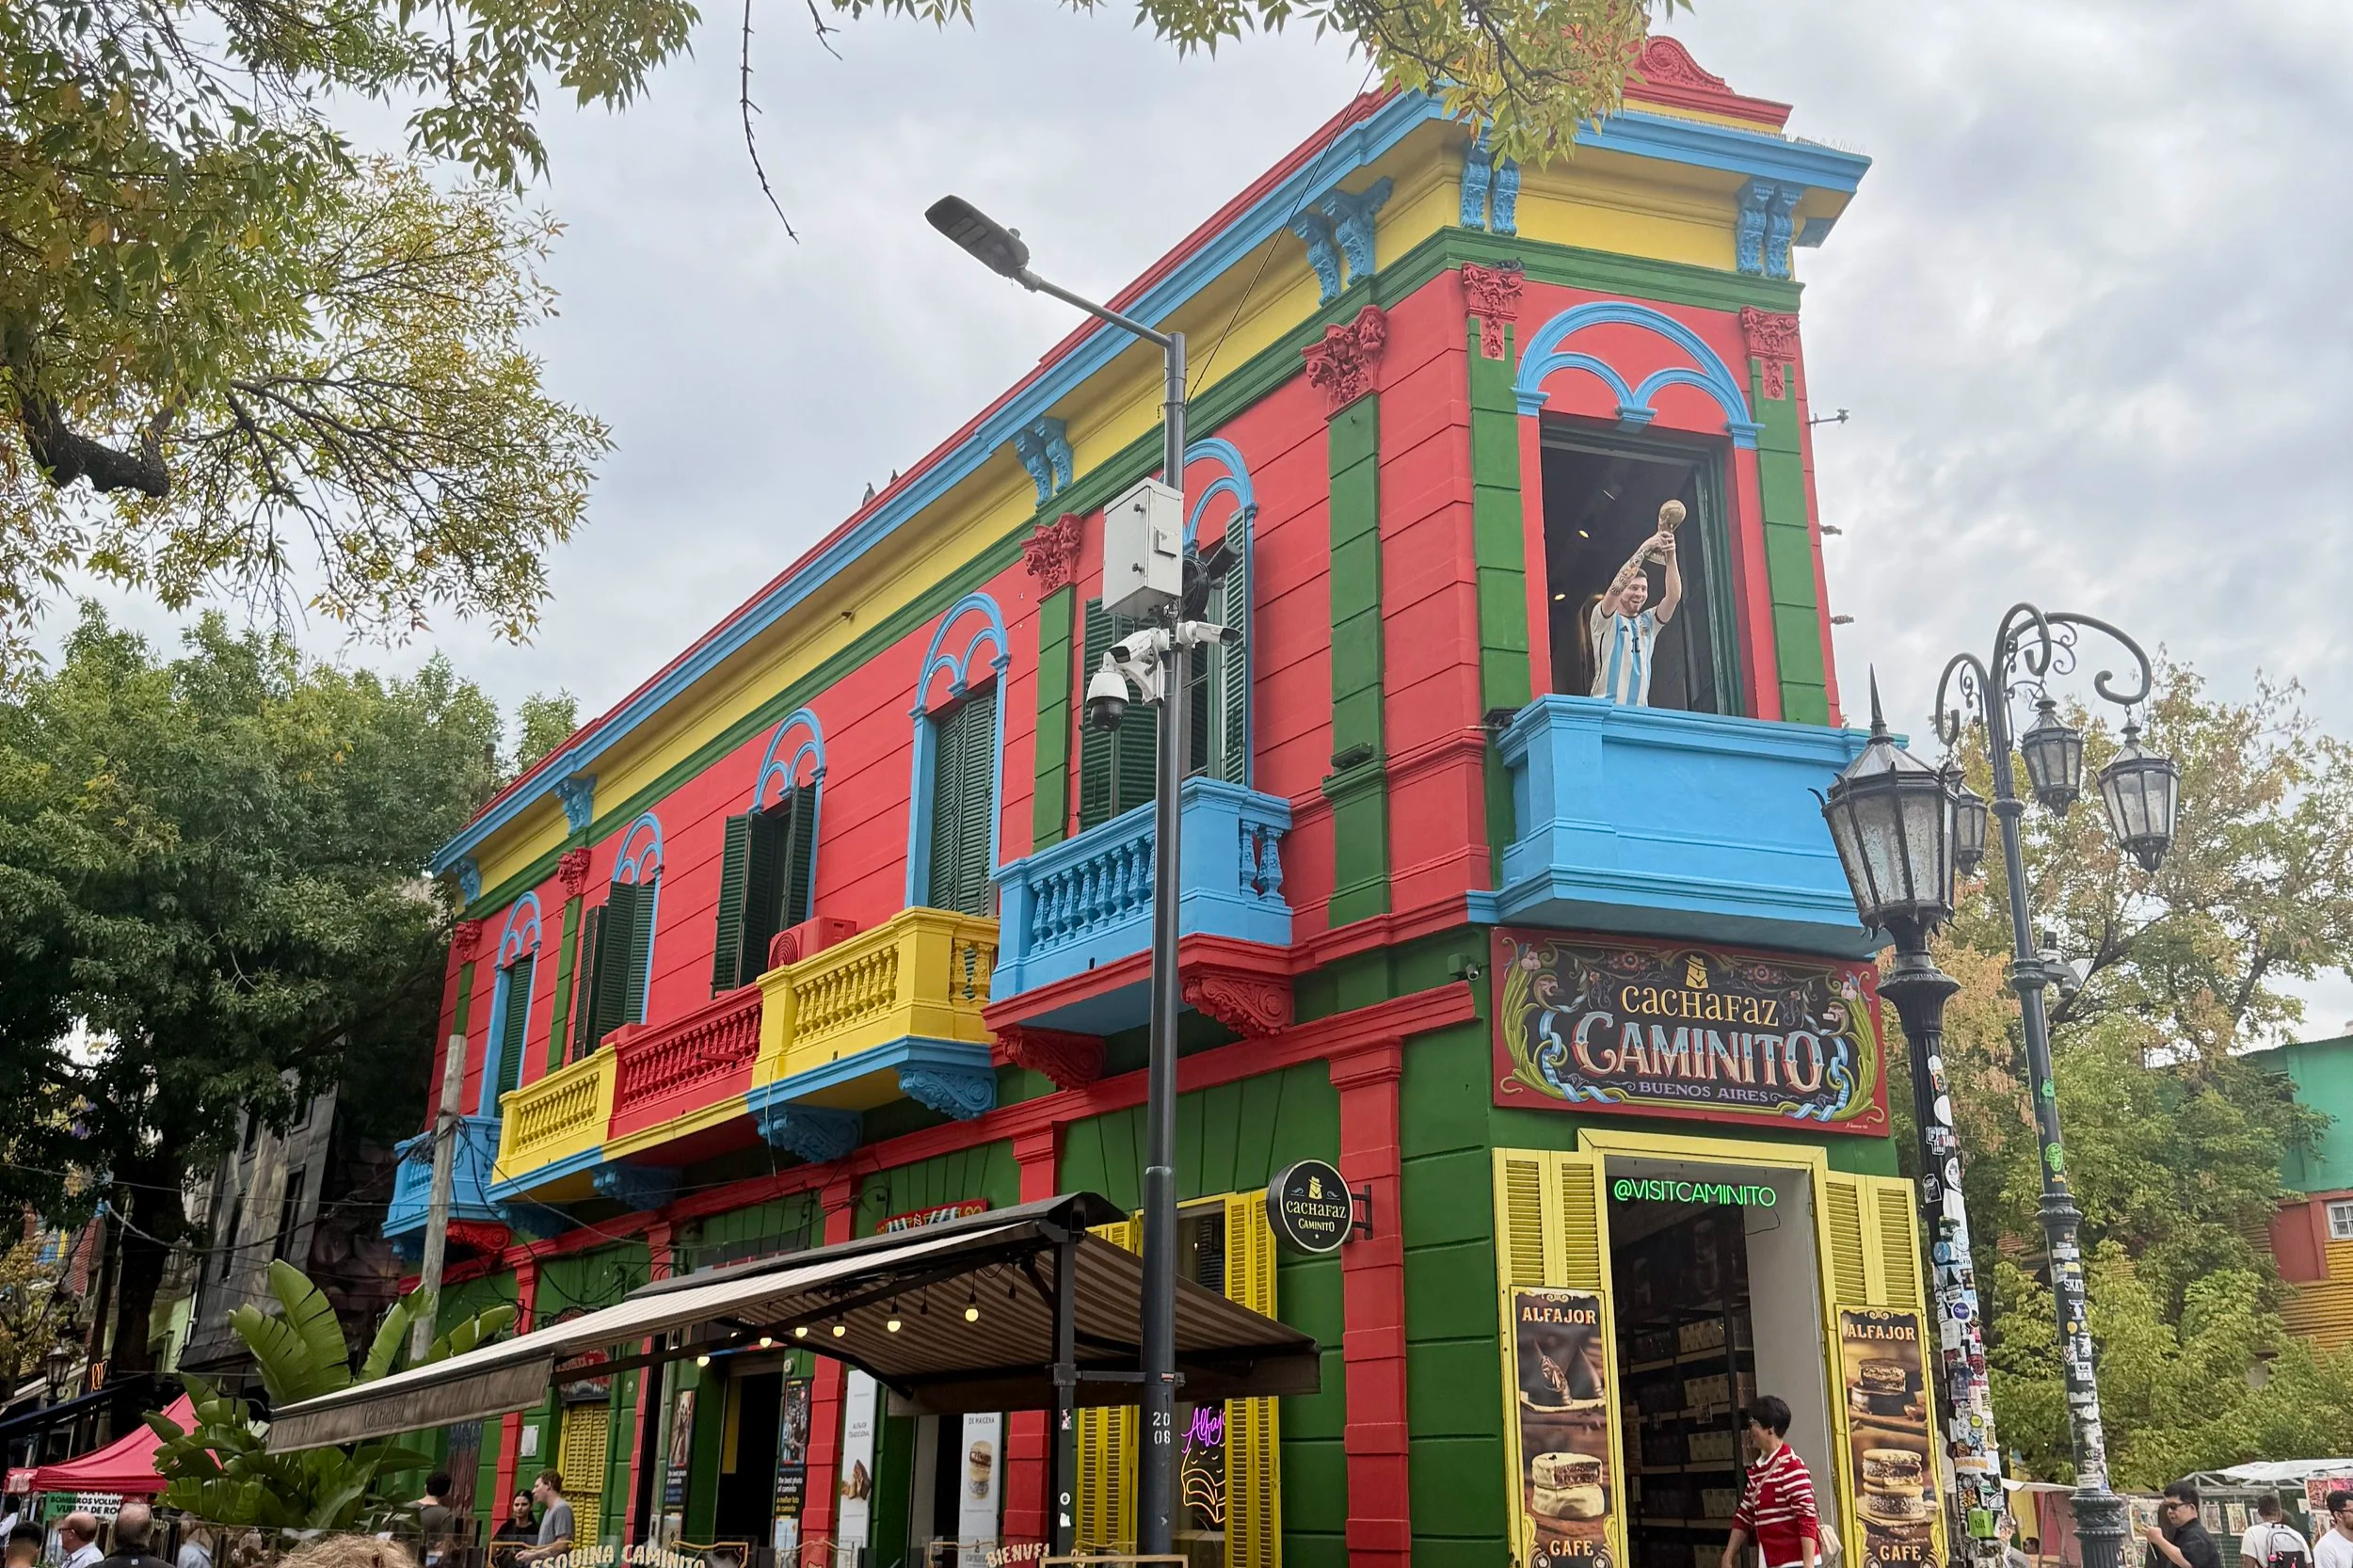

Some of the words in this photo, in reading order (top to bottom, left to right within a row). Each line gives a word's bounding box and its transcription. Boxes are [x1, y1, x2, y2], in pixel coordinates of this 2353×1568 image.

[1572, 1011, 1824, 1093] CAMINITO
[1639, 1081, 1711, 1098] BUENOS
[1717, 1088, 1769, 1103] AIRES
[1614, 1178, 1776, 1208] @VISITCAMINITO
[1298, 1218, 1335, 1232] CAMINITO
[1522, 1307, 1597, 1325] ALFAJOR
[1848, 1323, 1915, 1342] ALFAJOR
[1153, 1412, 1170, 1426] 20
[1154, 1431, 1170, 1444] 08
[51, 1496, 92, 1504] BOMBEROS
[91, 1506, 102, 1514] DE
[1550, 1540, 1593, 1557] CAFE
[1880, 1545, 1921, 1560] CAFE
